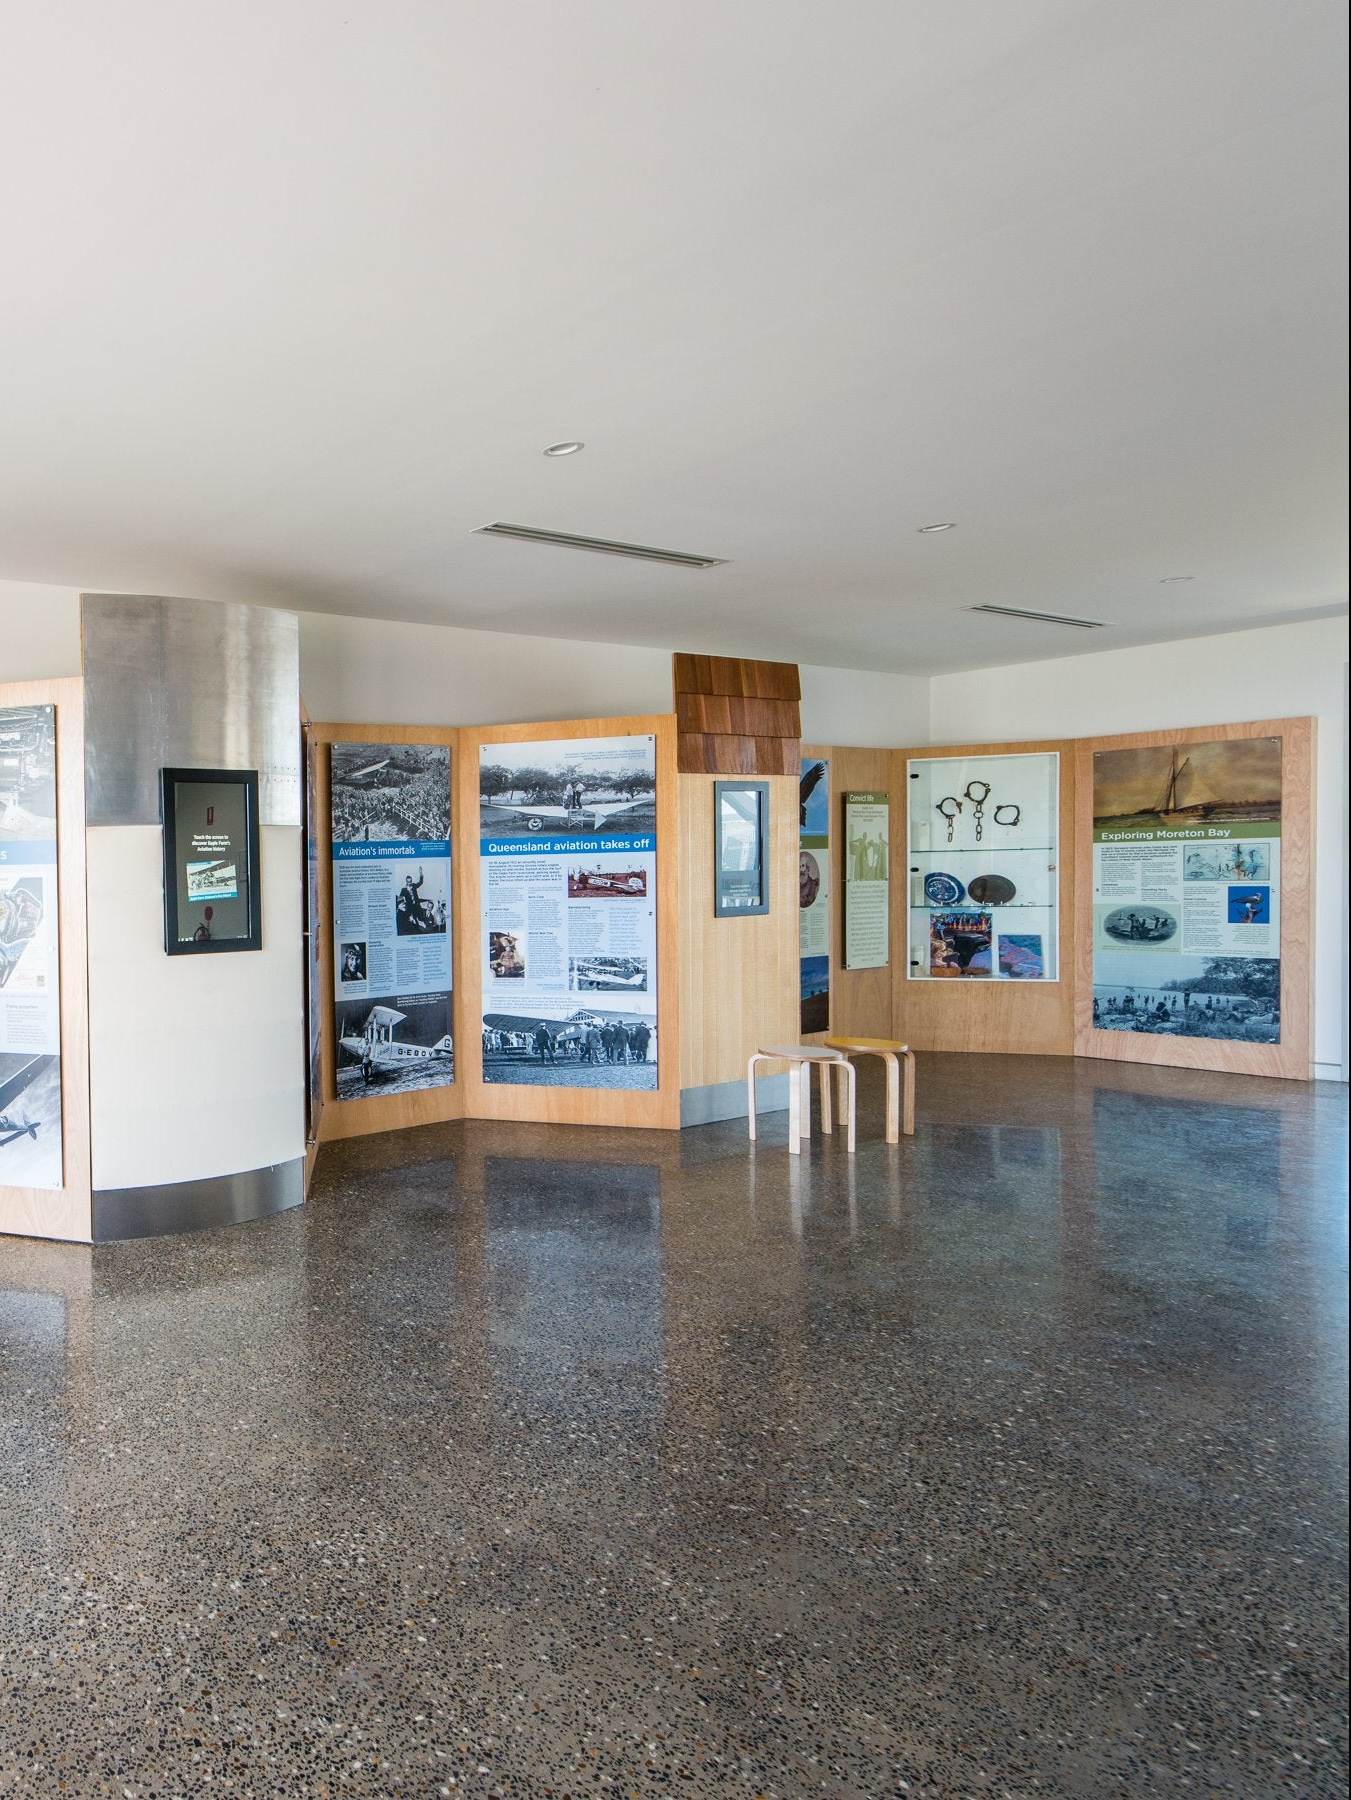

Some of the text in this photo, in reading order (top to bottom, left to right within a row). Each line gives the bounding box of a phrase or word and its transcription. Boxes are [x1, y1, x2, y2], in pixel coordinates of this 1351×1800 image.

[1102, 829, 1231, 841] Exploring Moreton Bay
[339, 847, 376, 856] Aviation's
[378, 846, 415, 855] immortals
[488, 839, 650, 852] Queensland aviation takes off
[444, 1039, 451, 1047] G
